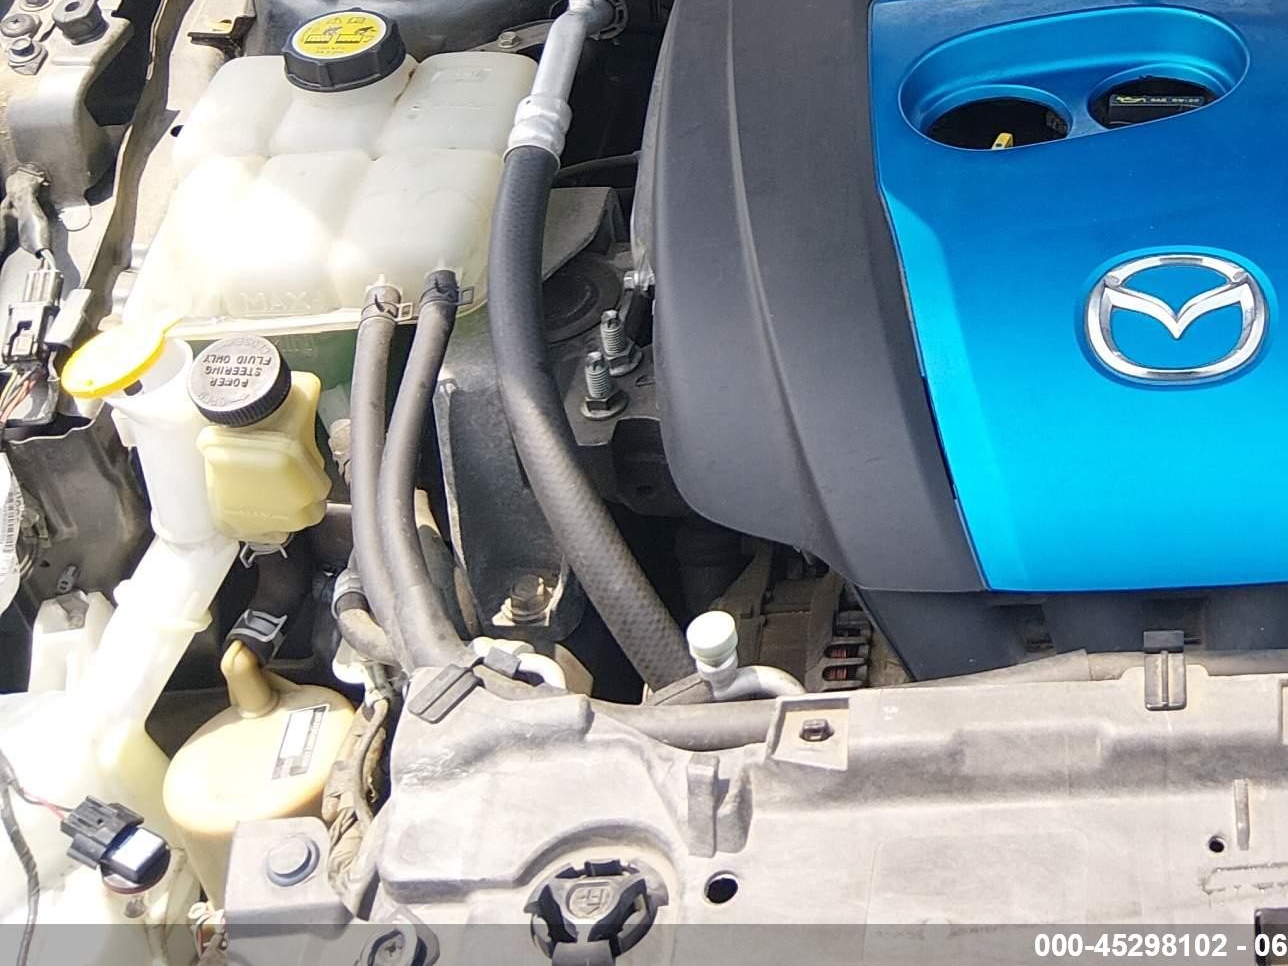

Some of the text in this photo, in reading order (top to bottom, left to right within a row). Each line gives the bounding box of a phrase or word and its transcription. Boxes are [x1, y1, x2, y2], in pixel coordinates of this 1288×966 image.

[240, 291, 312, 311] MAX
[203, 354, 272, 366] FLUID ONLY
[205, 366, 263, 377] STEERING
